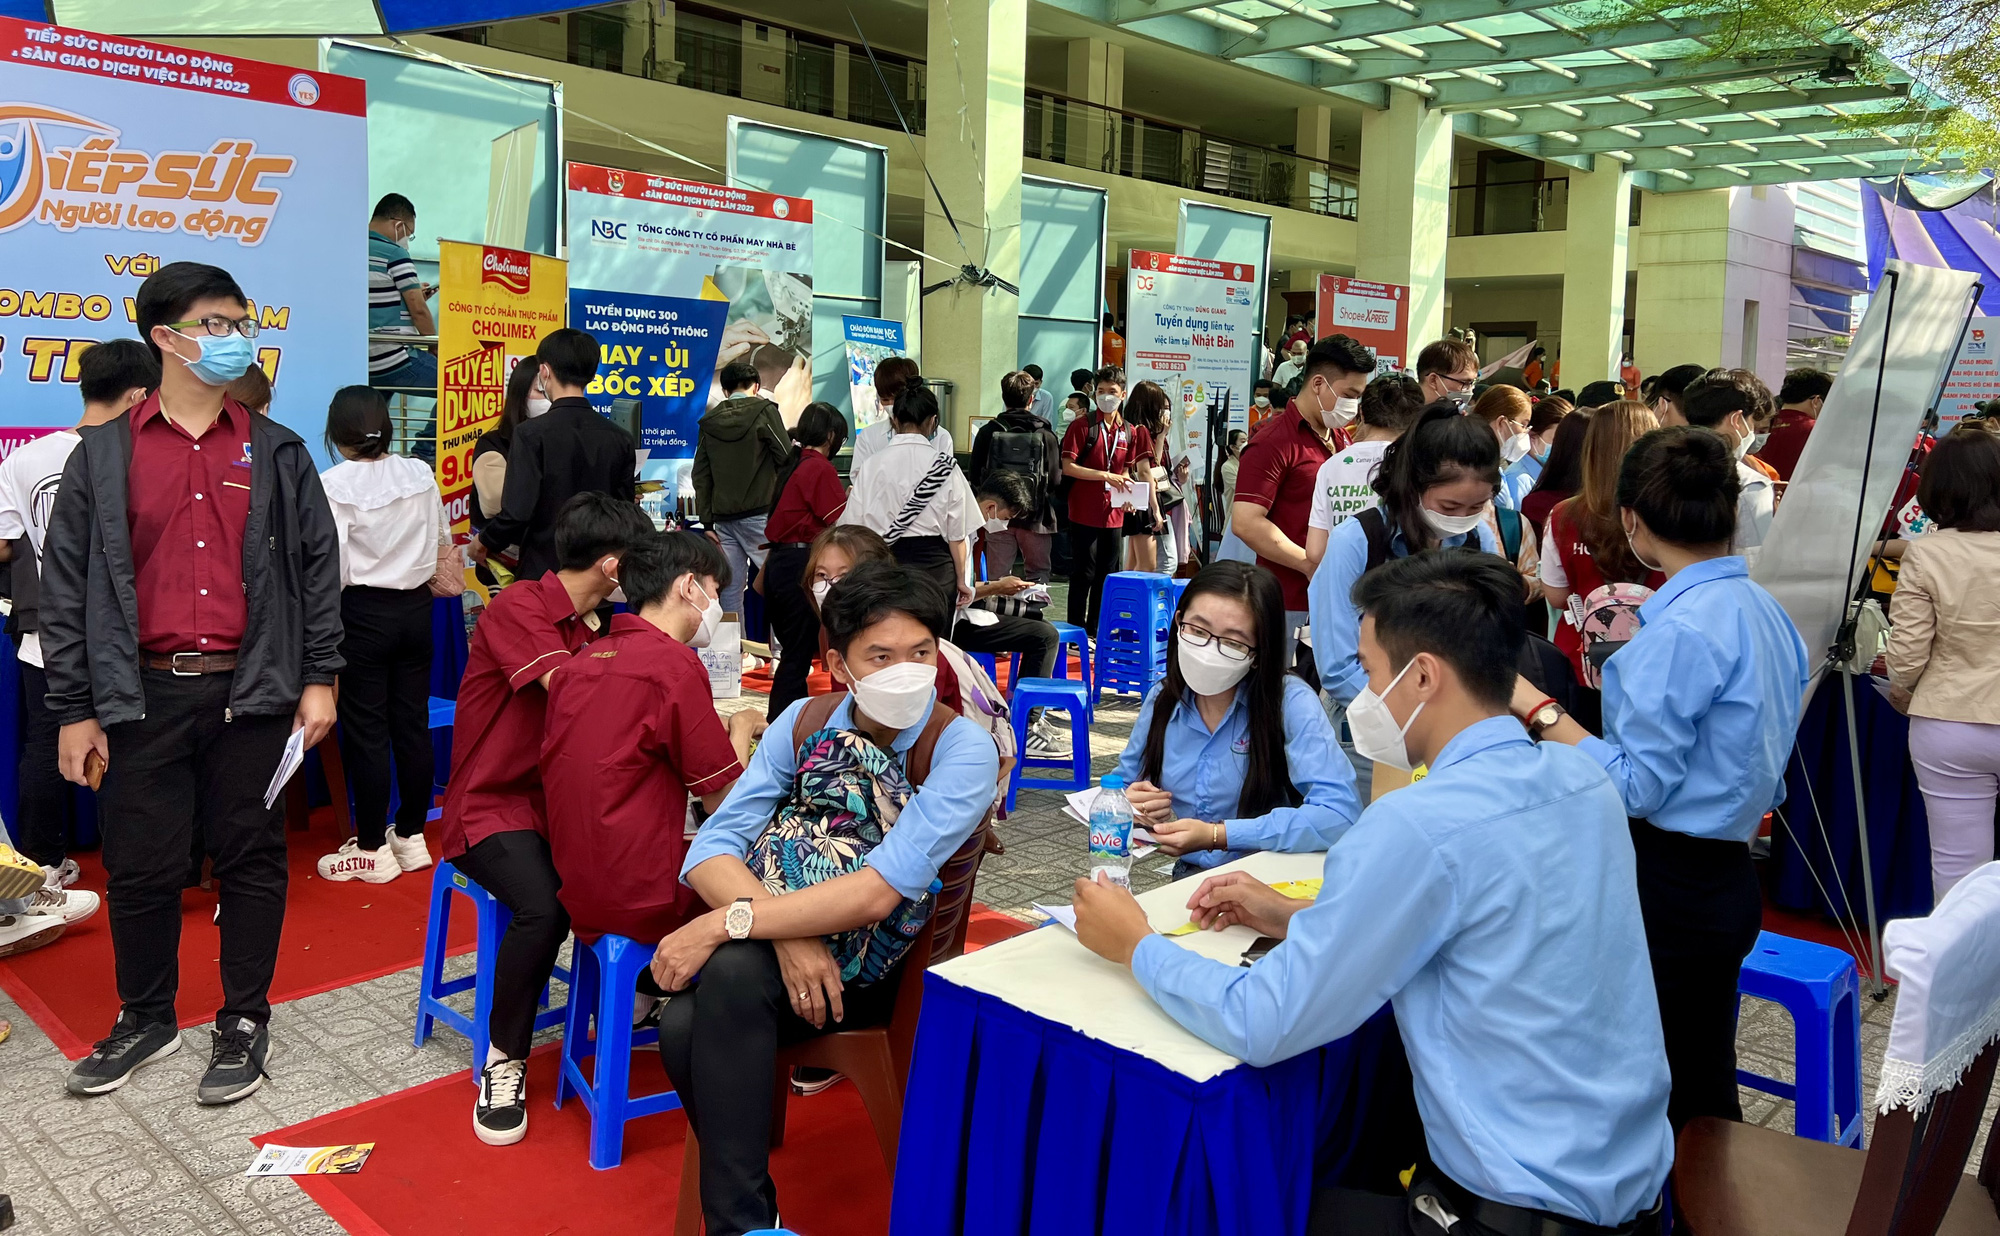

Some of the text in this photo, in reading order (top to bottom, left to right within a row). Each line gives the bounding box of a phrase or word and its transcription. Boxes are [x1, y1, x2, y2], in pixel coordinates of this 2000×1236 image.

[25, 27, 234, 74] TIẾP SỨC NGƯỜI LAO ĐỘNG
[21, 46, 57, 63] SÀN
[59, 53, 100, 70] GIAO
[102, 61, 141, 77] DỊCH
[143, 67, 178, 84] VIỆC
[180, 72, 213, 89] LÀM
[215, 79, 250, 94] 2022
[299, 91, 313, 100] YES
[137, 142, 293, 205] SỨC
[647, 178, 747, 200] TIẾP SỨC NGƯỜI LAO ĐỘNG
[645, 189, 663, 199] SÀN
[663, 193, 683, 202] GIAO
[683, 196, 702, 205] DỊCH
[702, 198, 720, 208] VIỆC
[720, 200, 736, 210] LÀM
[737, 204, 755, 213] 2022
[40, 199, 268, 243] Người lao động
[592, 219, 627, 240] NBC
[637, 223, 663, 235] TỔNG
[665, 227, 691, 238] CÔNG
[693, 231, 704, 240] TY
[705, 231, 718, 241] CỔ
[746, 238, 765, 248] MAY
[766, 239, 784, 250] NHÀ
[105, 253, 160, 277] VỚI
[483, 254, 529, 277] Cholimex
[448, 301, 472, 313] CÔNG
[474, 305, 482, 314] TY
[484, 302, 496, 316] CỔ
[519, 310, 537, 322] THỰC
[538, 309, 558, 322] PHẨM
[585, 303, 678, 321] TUYỂN DỤNG 300
[1163, 303, 1175, 311] CÔNG
[1211, 307, 1227, 315] GIANG
[1340, 307, 1388, 324] Shopee XPRESS
[472, 320, 537, 340] CHOLIMEX
[585, 320, 709, 338] LAO ĐỘNG PHỔ THÔNG
[1155, 313, 1235, 333] Tuyển dụng liên tục
[1154, 334, 1234, 350] việc làm tại Nhật Bản
[664, 340, 689, 369] ỦI
[445, 346, 504, 386] TUYỂN
[1155, 362, 1170, 370] 1900
[586, 368, 695, 398] BỐC XẾP
[445, 390, 502, 432] DỤNG!
[442, 428, 483, 450] THU NHẬP
[645, 428, 677, 437] thời gian.
[651, 438, 668, 447] triệu
[668, 437, 688, 448] đồng.
